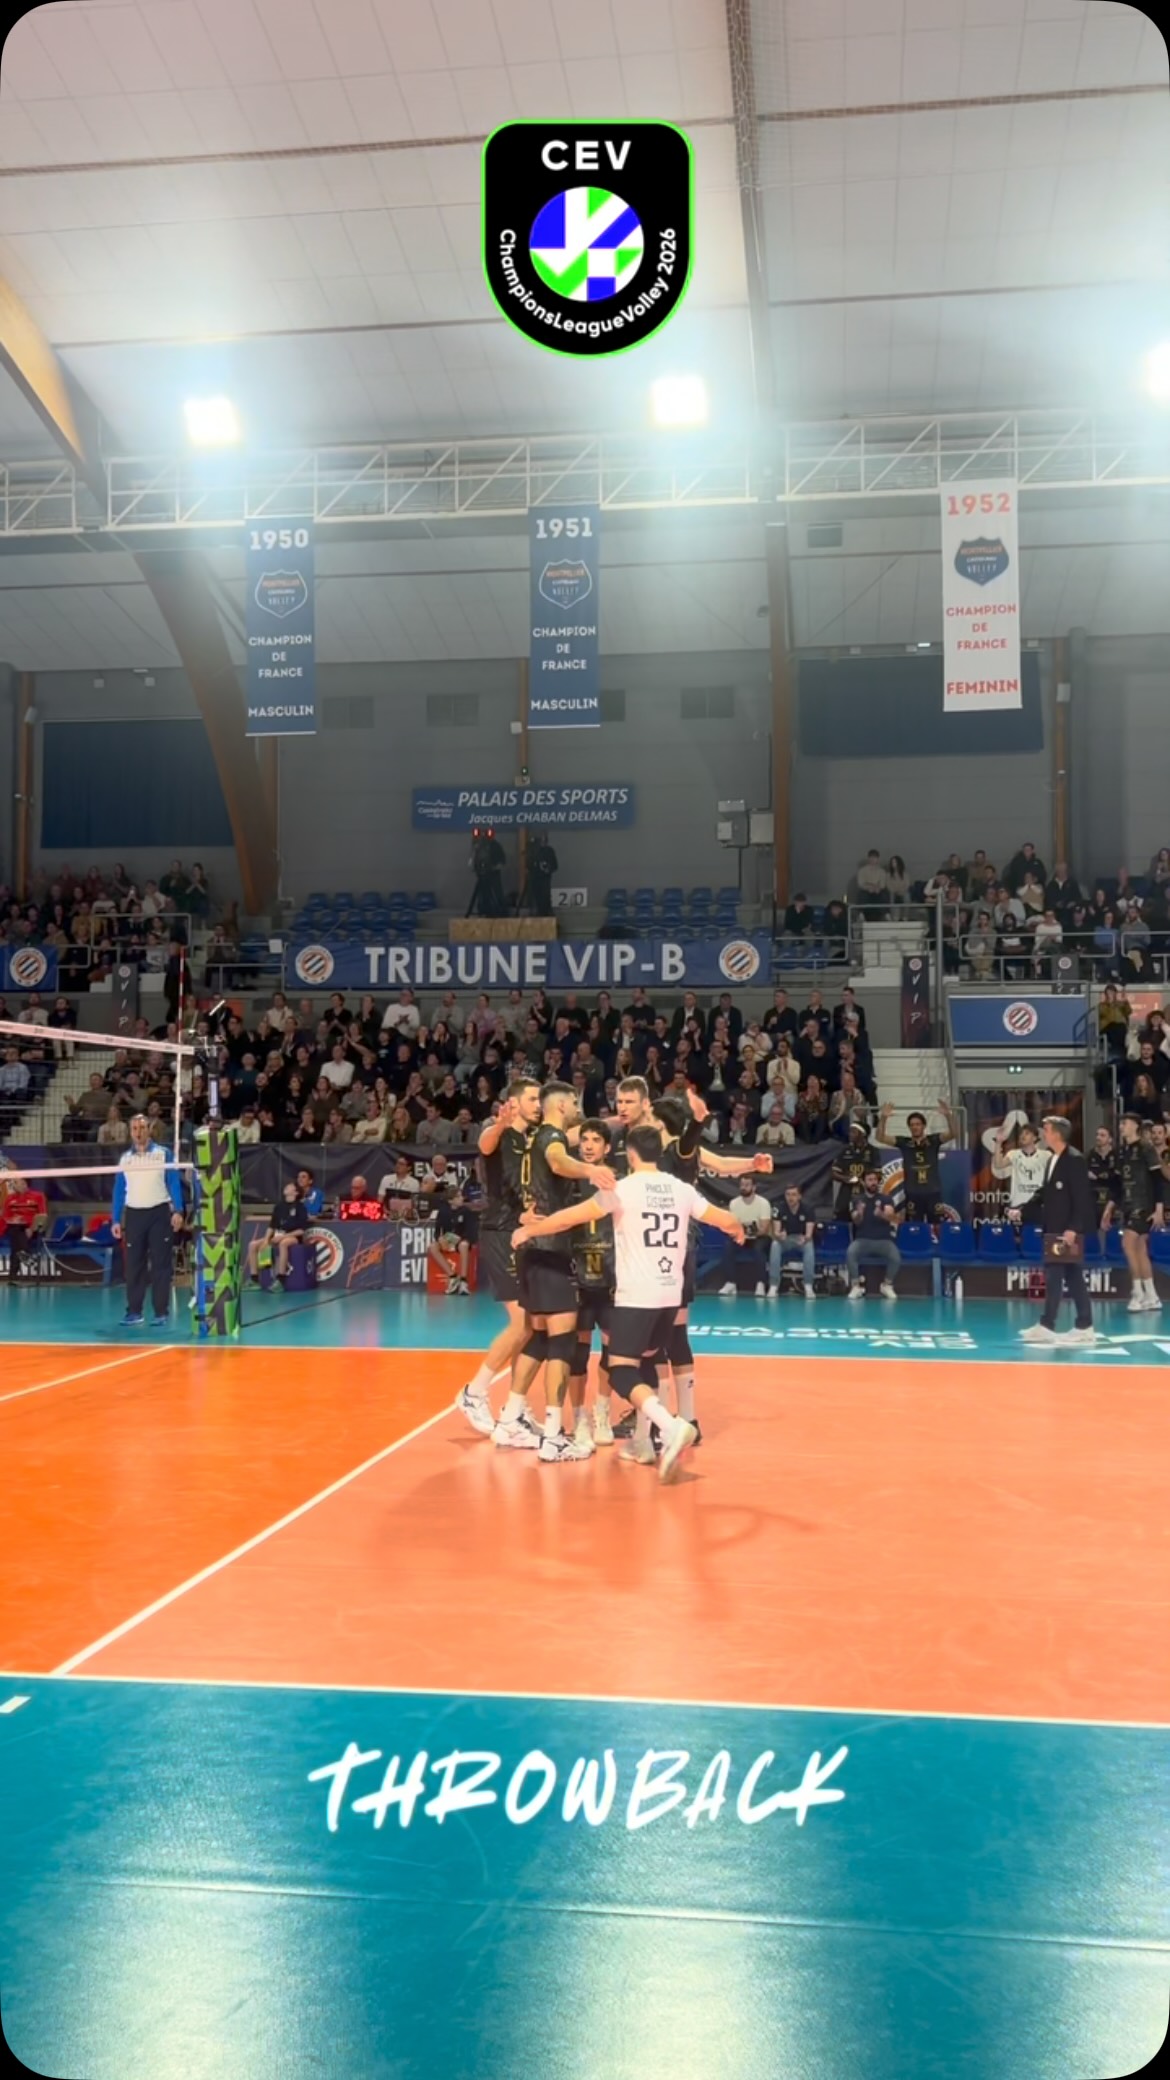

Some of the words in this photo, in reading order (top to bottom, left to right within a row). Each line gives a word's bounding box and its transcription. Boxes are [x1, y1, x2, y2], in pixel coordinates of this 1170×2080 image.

[947, 493, 1011, 515] 1952
[536, 518, 592, 539] 1951
[250, 528, 309, 550] 1950
[946, 604, 1016, 617] CHAMPION
[532, 626, 596, 638] CHAMPION
[972, 622, 988, 633] DE
[248, 634, 312, 646] CHAMPION
[957, 638, 1007, 650] FRANCE
[556, 643, 570, 654] DE
[272, 652, 287, 662] DE
[542, 659, 587, 670] FRANCE
[258, 667, 303, 679] FRANCE
[946, 679, 1018, 695] FEMININ
[531, 697, 598, 711] MASCULIN
[248, 705, 314, 718] MASCULIN
[458, 791, 518, 807] PALAIS
[522, 790, 556, 806] DES
[560, 788, 629, 805] SPORTS
[468, 813, 513, 826] Jacques
[516, 812, 566, 824] CHABAN
[568, 810, 618, 822] DELMAS
[364, 946, 547, 985] TRIBUNE
[562, 943, 686, 983] VIP-B
[642, 1212, 680, 1248] 22
